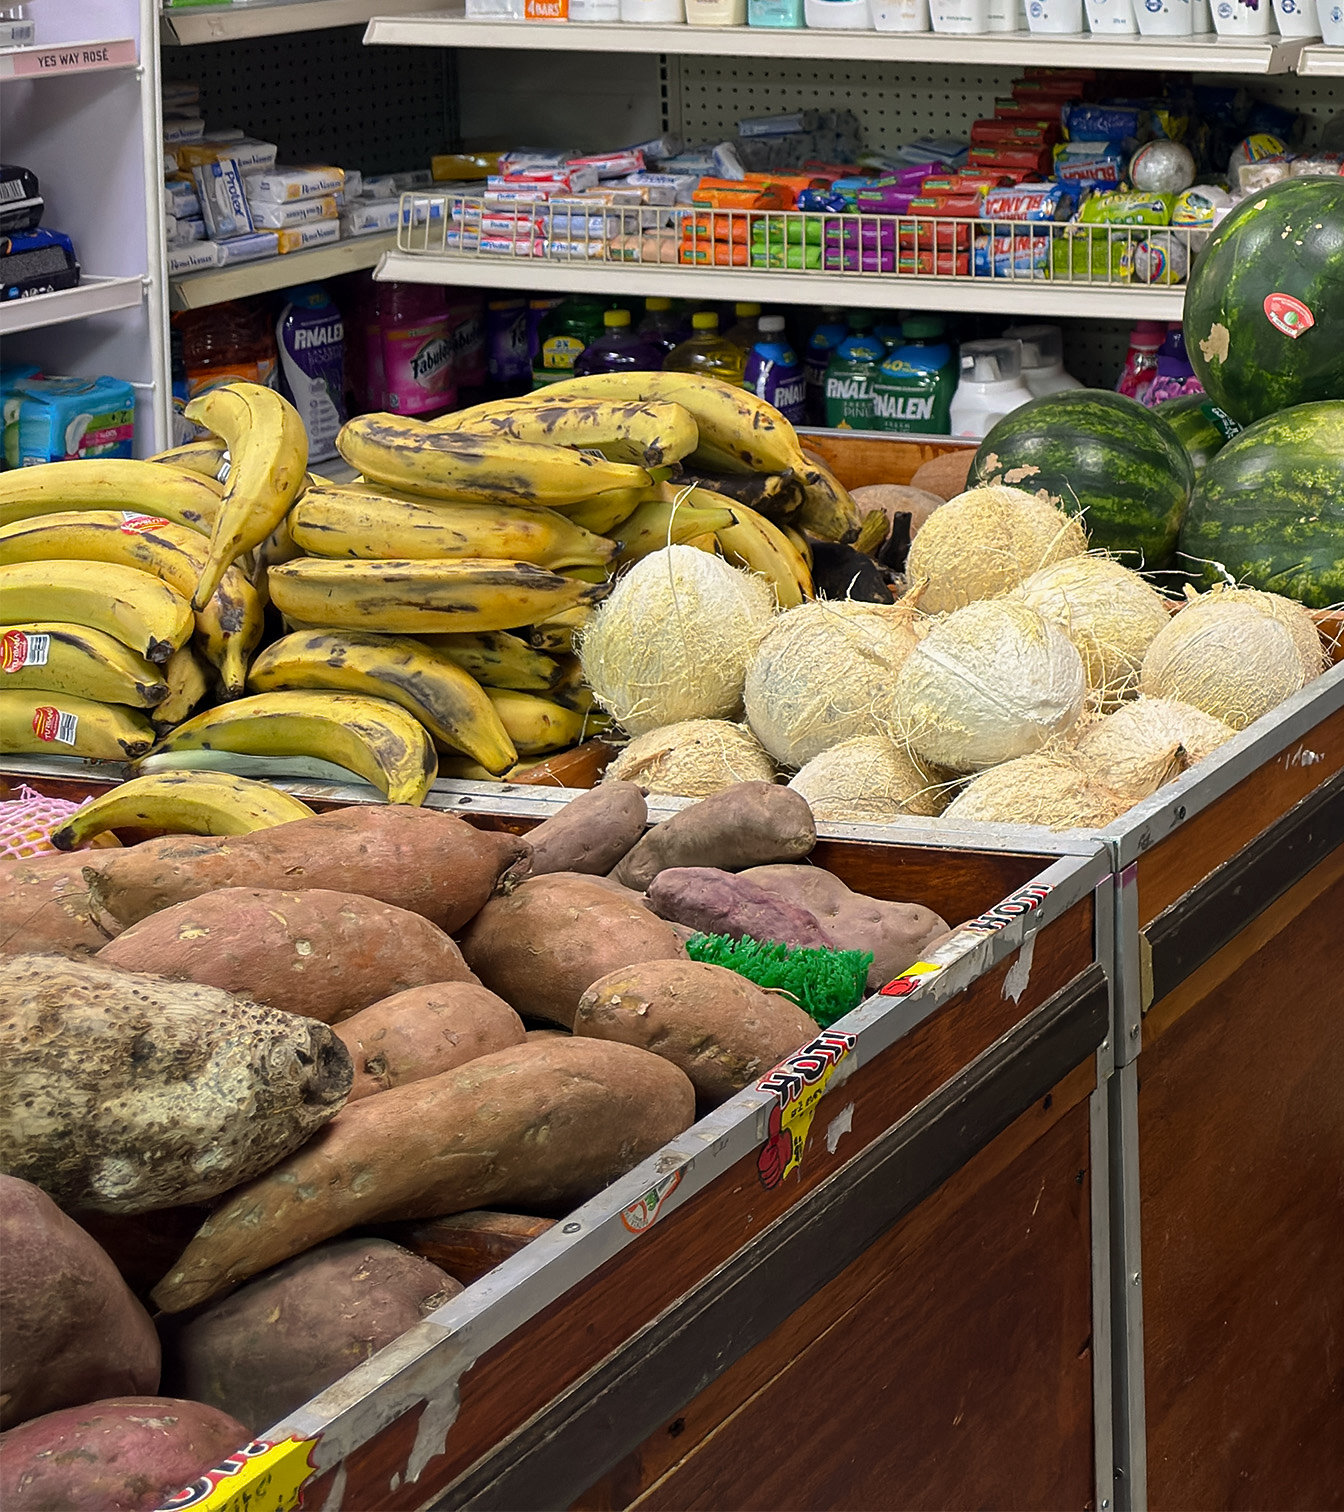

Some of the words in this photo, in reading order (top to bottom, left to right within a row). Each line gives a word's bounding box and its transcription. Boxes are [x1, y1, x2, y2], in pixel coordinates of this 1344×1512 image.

[528, 0, 535, 15] 4
[537, 1, 560, 16] BARS
[37, 55, 57, 68] YES
[59, 52, 79, 66] WAY
[80, 47, 110, 64] ROSÉ
